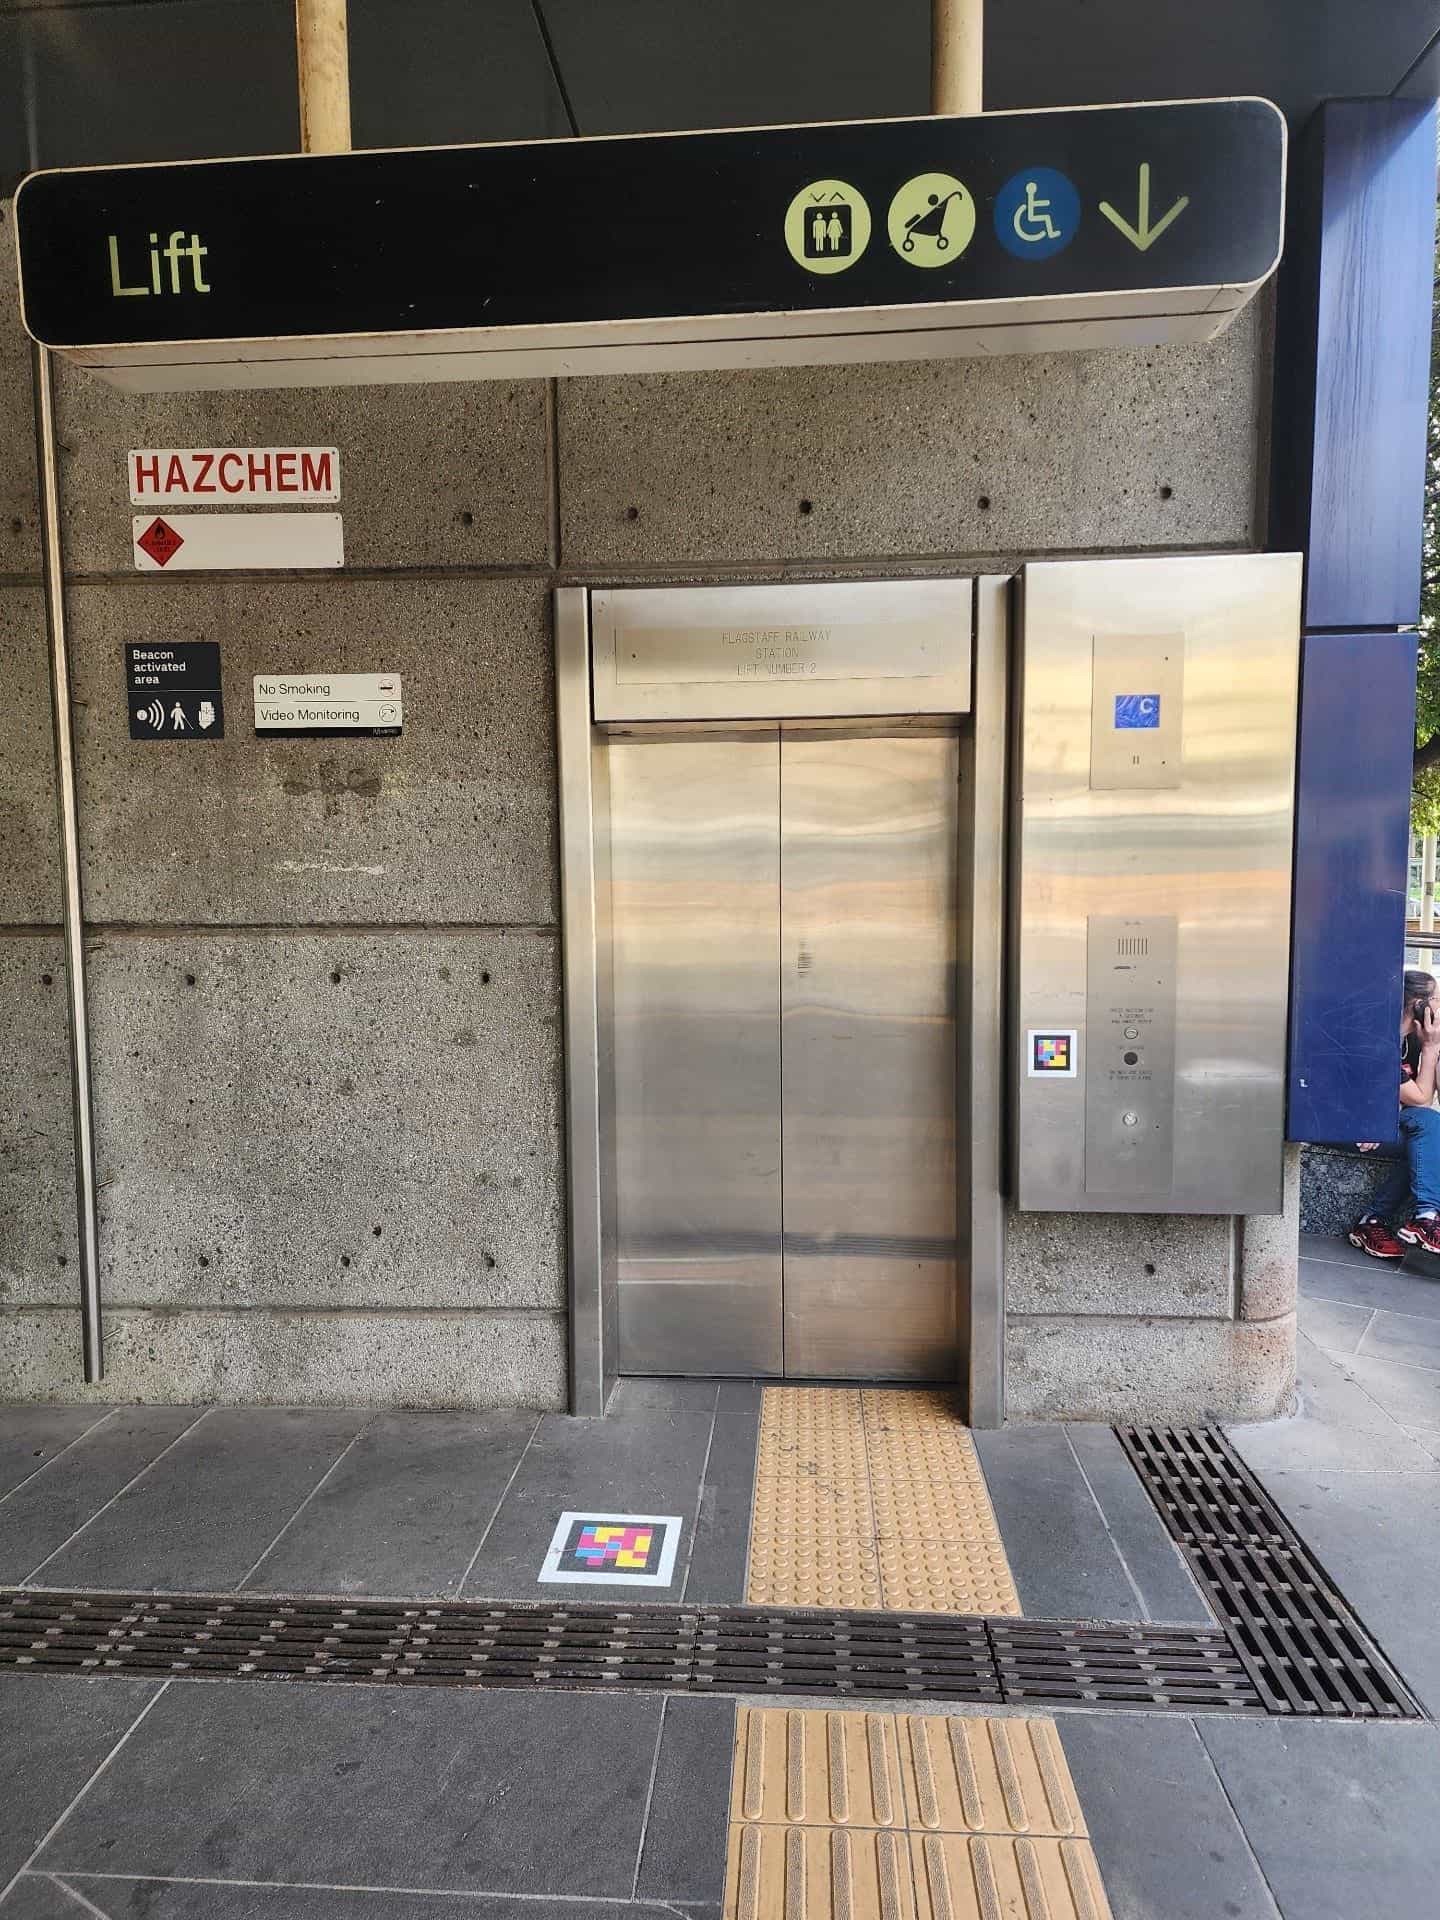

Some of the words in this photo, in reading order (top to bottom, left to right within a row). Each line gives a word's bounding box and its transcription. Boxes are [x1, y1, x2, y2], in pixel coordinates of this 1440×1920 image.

[108, 230, 211, 296] Lift
[135, 452, 332, 493] HAZCHEM
[721, 631, 780, 644] FLAGSTAFF
[132, 649, 174, 660] Beacon
[756, 647, 799, 659] STATION
[134, 661, 186, 672] activated
[134, 676, 160, 685] area
[259, 684, 276, 695] No
[279, 683, 331, 697] Smoking
[261, 709, 295, 721] Video
[298, 709, 360, 723] Monitoring
